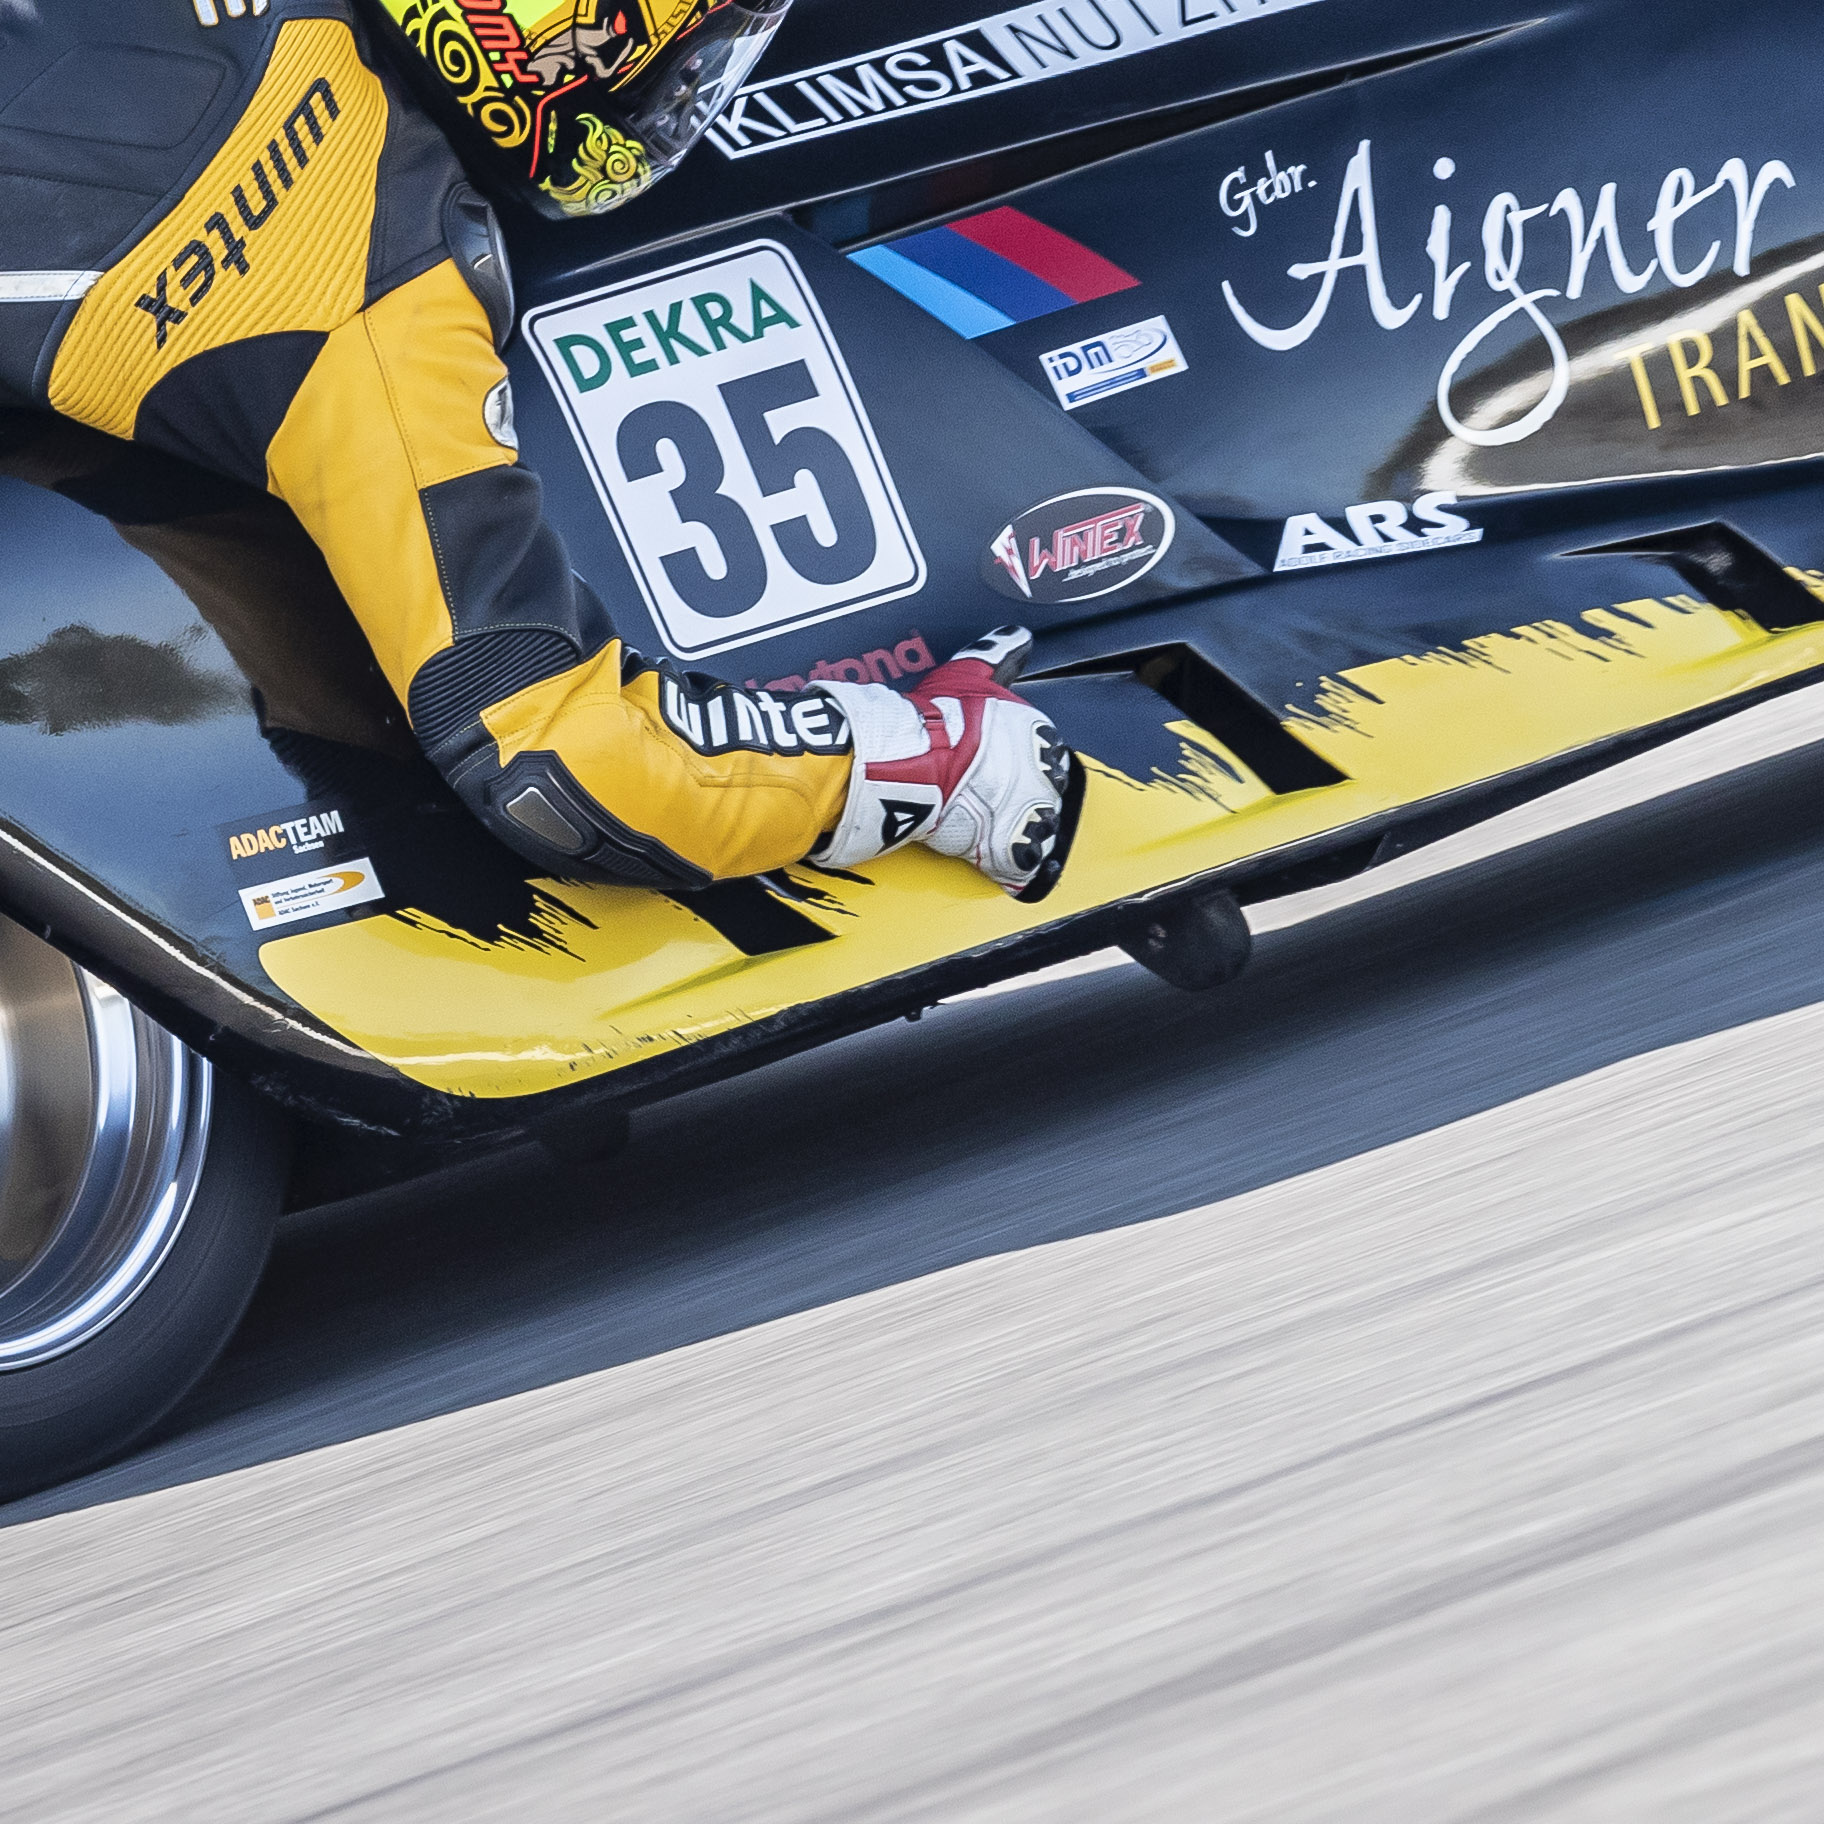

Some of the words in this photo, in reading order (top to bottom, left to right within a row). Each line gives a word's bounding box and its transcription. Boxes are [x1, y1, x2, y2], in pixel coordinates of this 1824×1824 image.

[719, 33, 1016, 151] KLIMSA
[1218, 148, 1317, 238] Gebr.
[552, 276, 804, 394] DEKRA
[1221, 138, 1796, 447] Aigner
[614, 366, 880, 622] 35
[1274, 490, 1471, 561] ARS
[1028, 502, 1145, 580] WINTEX
[746, 629, 936, 693] tona
[292, 840, 325, 855] Sachsen
